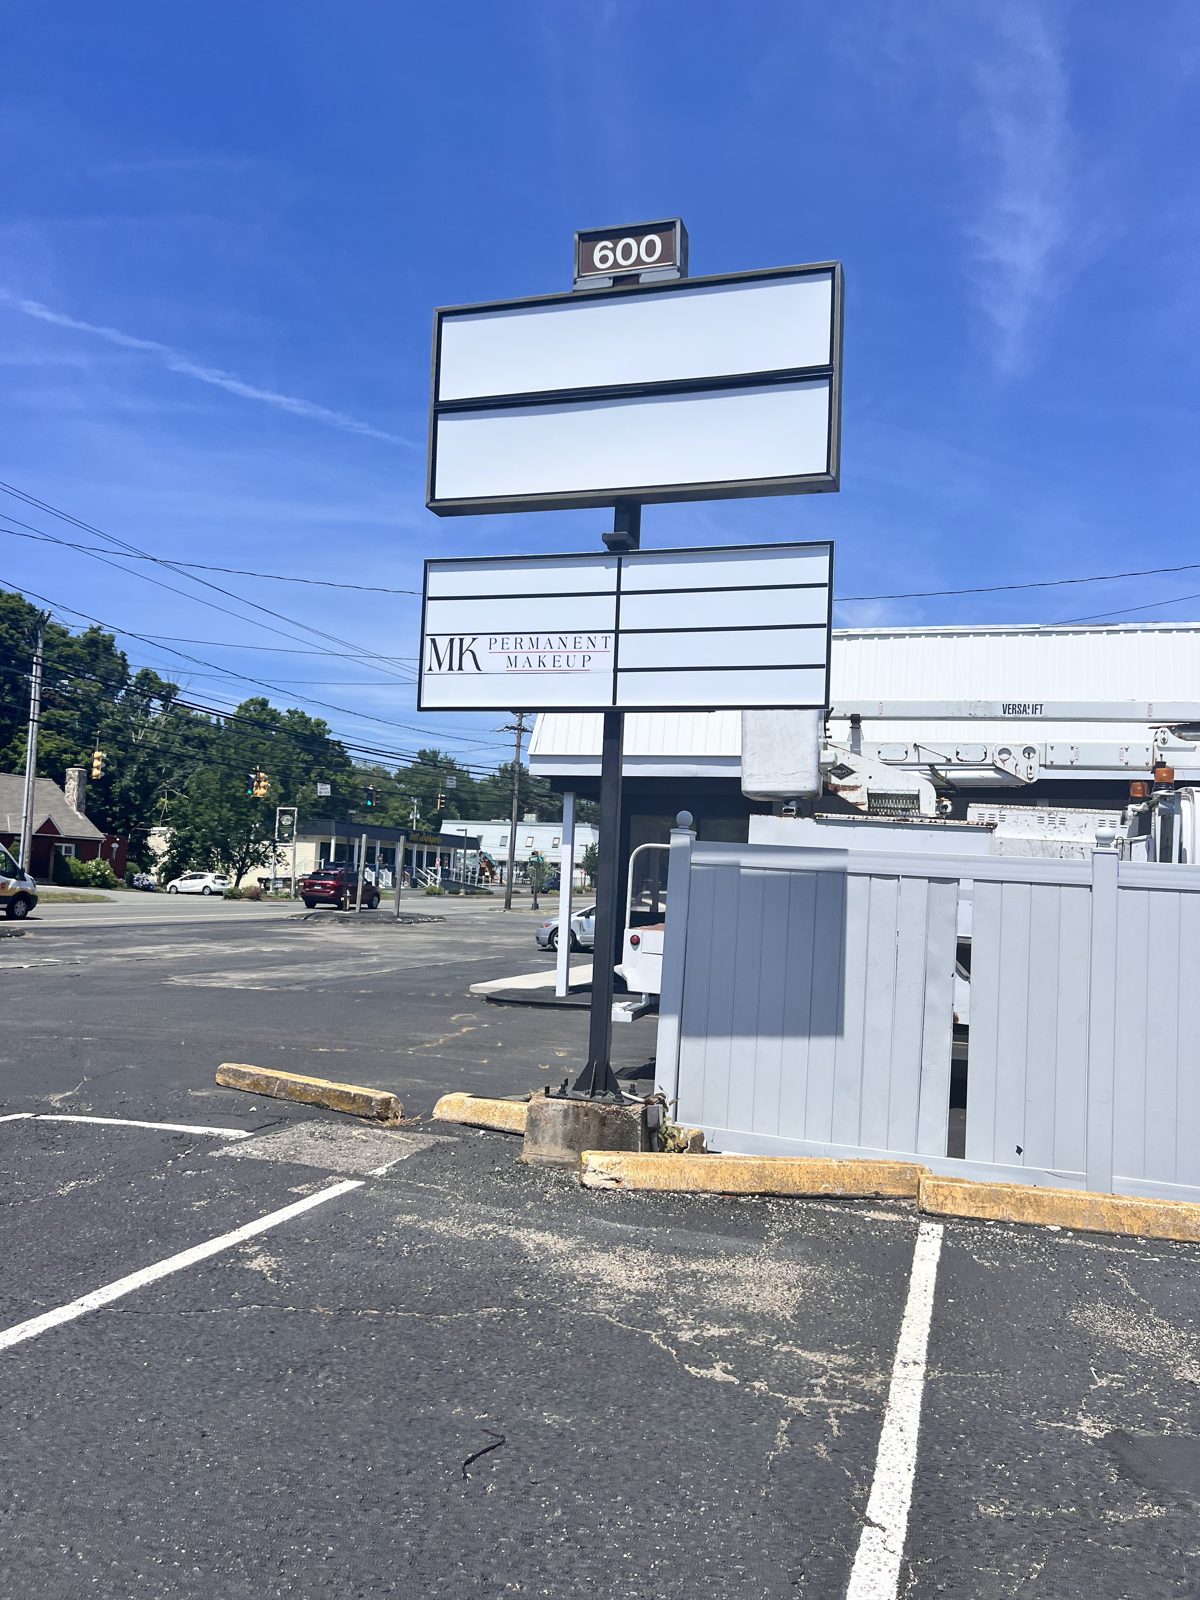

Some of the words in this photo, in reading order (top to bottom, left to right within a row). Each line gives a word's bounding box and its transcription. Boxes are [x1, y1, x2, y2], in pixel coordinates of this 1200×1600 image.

[593, 234, 662, 269] 600
[427, 637, 483, 672] MK
[488, 635, 612, 651] PERMANENT
[506, 654, 592, 669] MAKEUP
